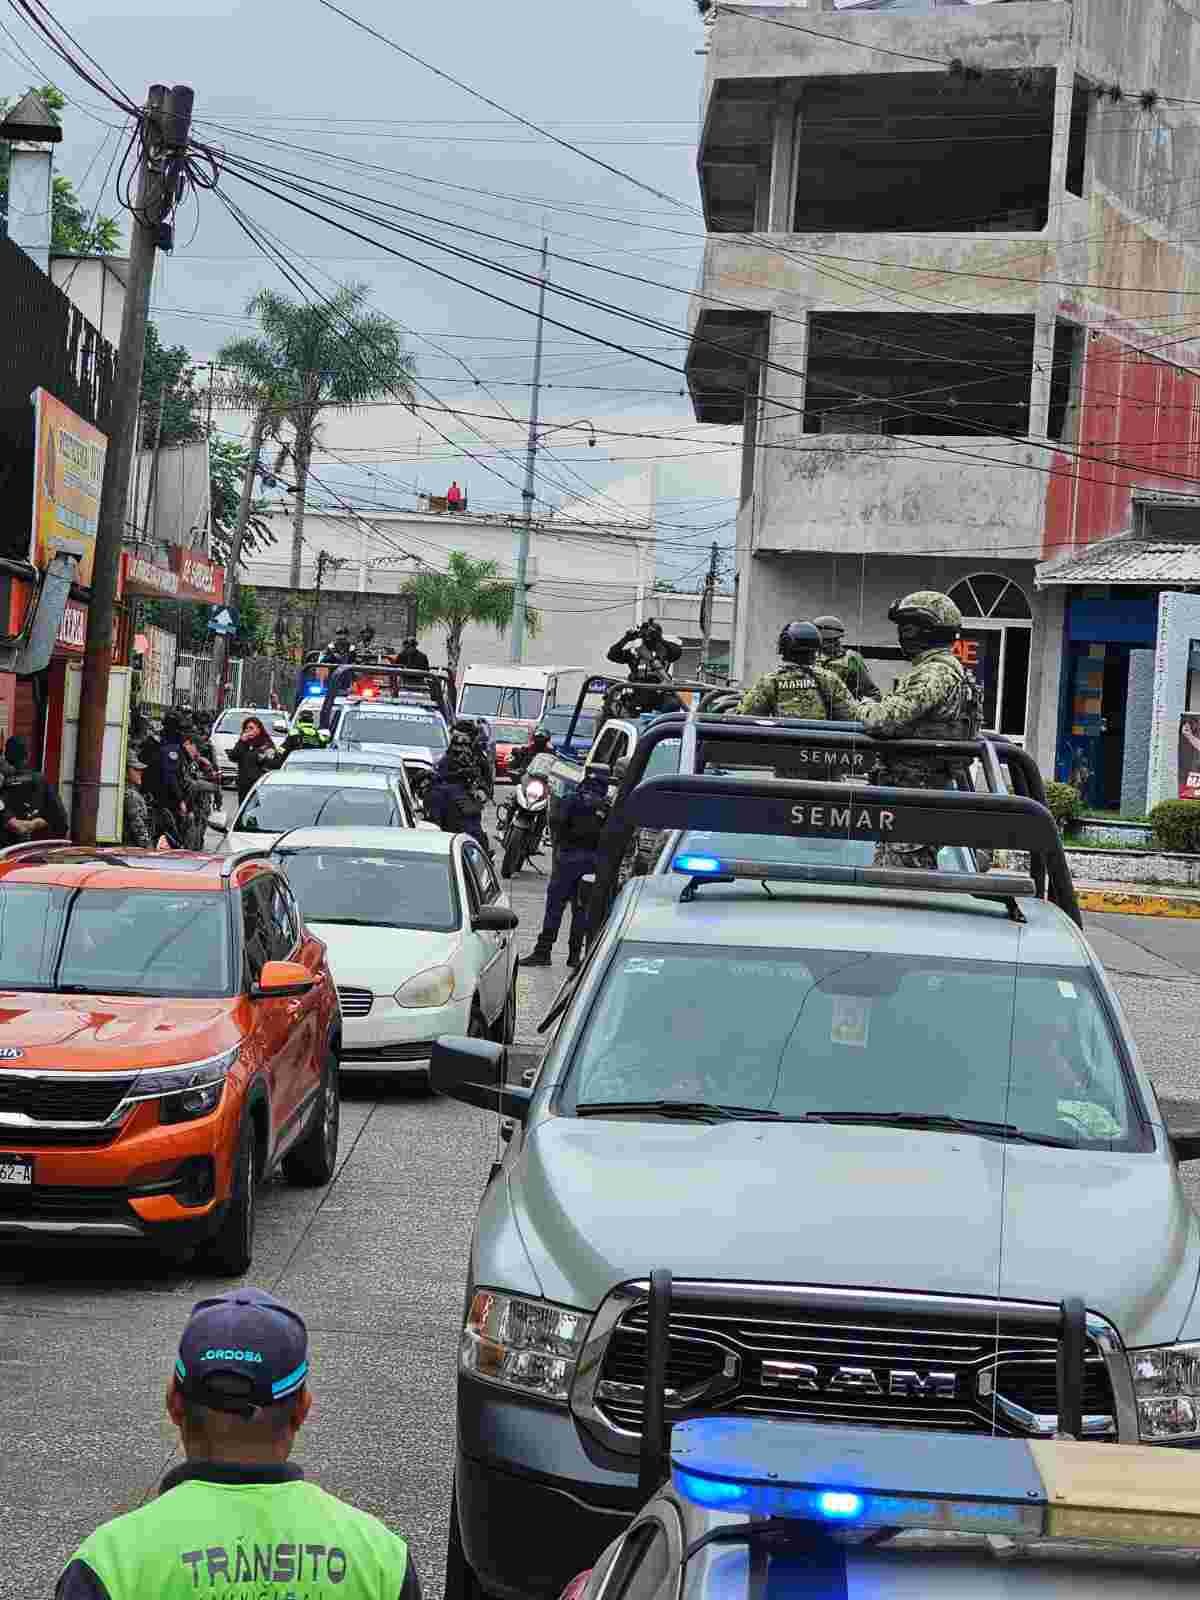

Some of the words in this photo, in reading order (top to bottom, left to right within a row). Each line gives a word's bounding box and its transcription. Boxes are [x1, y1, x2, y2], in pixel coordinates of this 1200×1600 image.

[799, 749, 864, 766] SEMAR
[791, 805, 895, 831] SEMAR
[760, 1359, 957, 1399] RAM
